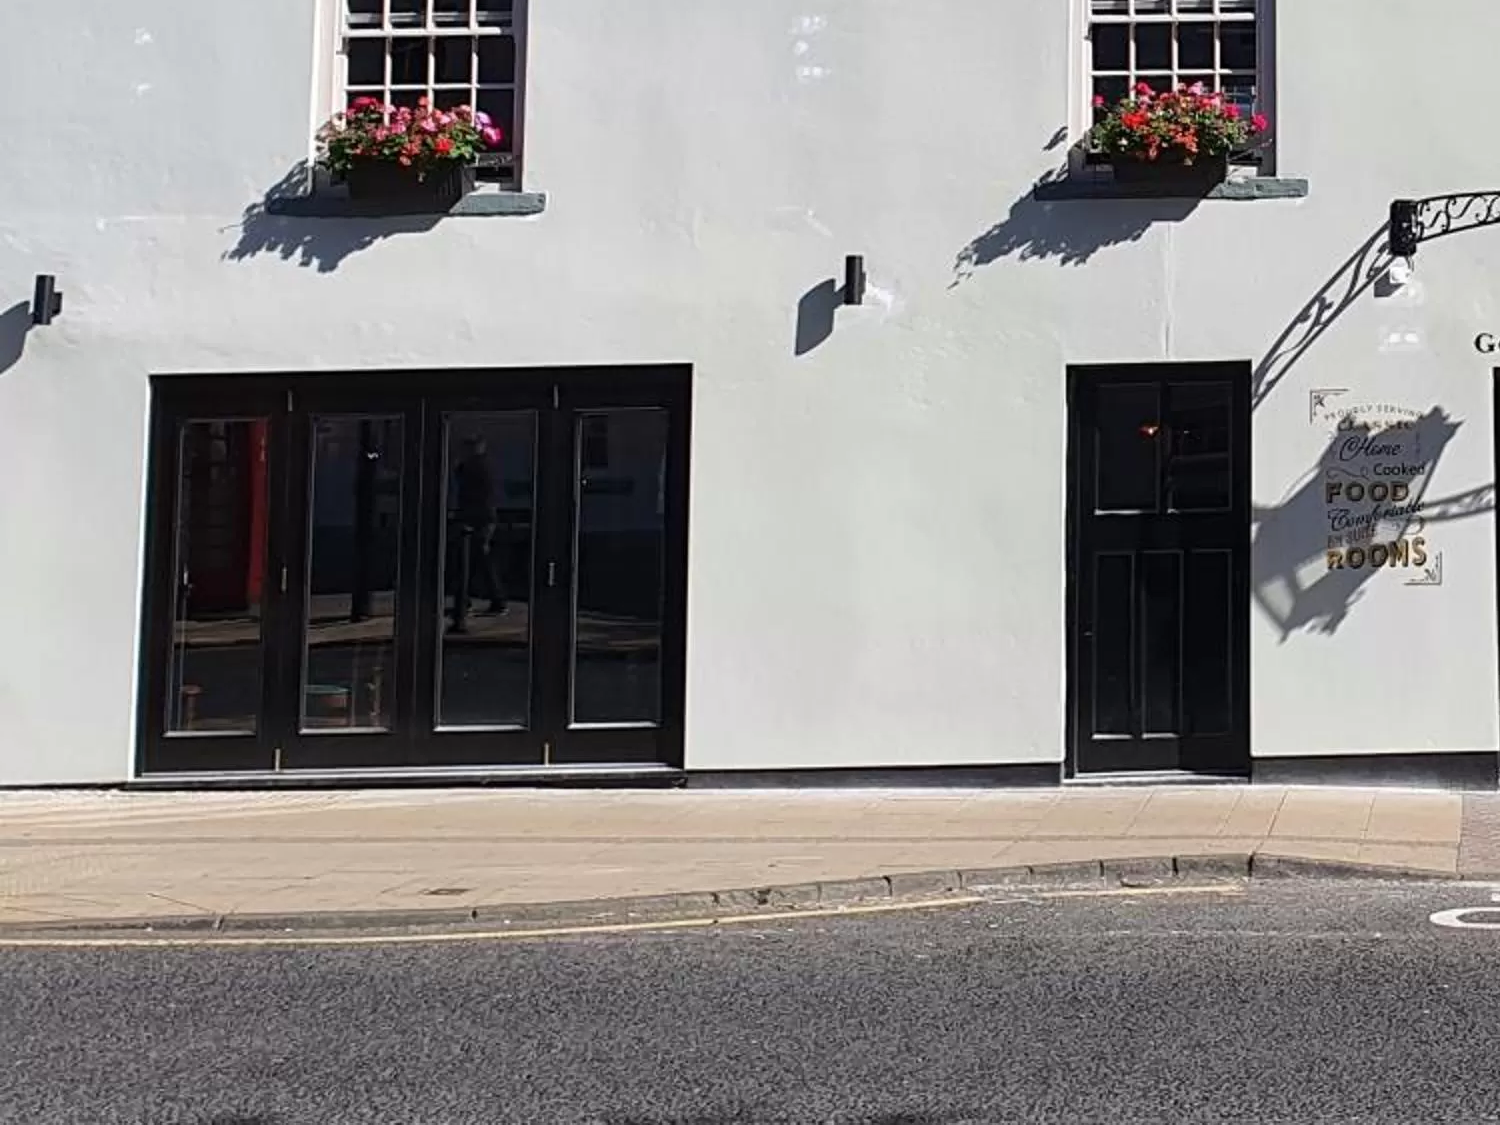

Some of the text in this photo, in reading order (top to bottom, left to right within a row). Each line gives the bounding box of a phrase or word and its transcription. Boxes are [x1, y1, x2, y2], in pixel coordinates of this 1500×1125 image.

[1339, 435, 1403, 461] Home
[1373, 462, 1425, 476] Cooked
[1326, 481, 1409, 504] FOOD
[1326, 536, 1428, 570] ROOMS
